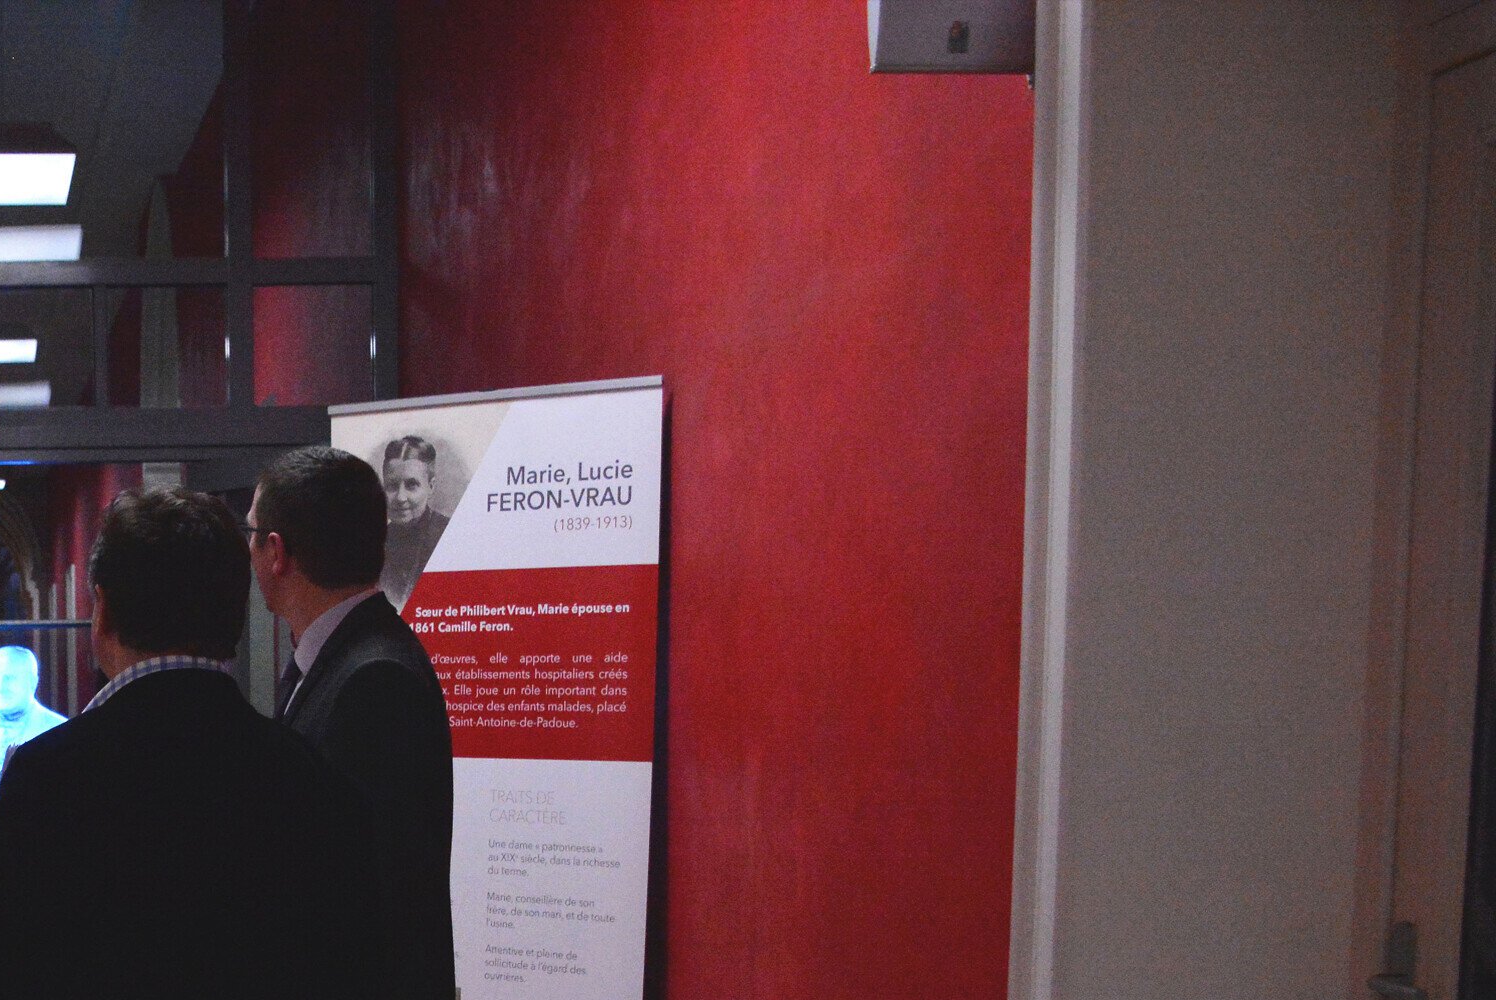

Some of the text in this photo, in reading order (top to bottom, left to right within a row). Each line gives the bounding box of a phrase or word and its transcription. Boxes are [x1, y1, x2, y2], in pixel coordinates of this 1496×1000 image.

[506, 459, 633, 486] Marie, Lucie
[487, 485, 633, 512] FERON-VRAU
[554, 515, 633, 533] (1839-1913)
[415, 603, 630, 618] Sœur de Philibert Vrau, Marie épouse en
[409, 622, 513, 633] 1861 Camille Feron.
[489, 653, 508, 664] elle
[519, 654, 560, 666] apporte
[572, 654, 592, 663] une
[604, 652, 628, 663] aide
[455, 667, 530, 680] établissements
[534, 667, 594, 682] hospitaliers
[598, 669, 627, 680] créés
[454, 685, 472, 695] Elle
[476, 685, 498, 697] joue
[503, 686, 516, 695] un
[521, 684, 540, 695] rôle
[545, 685, 596, 697] important
[601, 685, 627, 695] dans
[487, 701, 505, 712] des
[508, 701, 545, 712] enfants
[548, 701, 594, 713] malades,
[597, 702, 626, 714] placé
[536, 790, 555, 805] DE
[488, 840, 506, 849] Une
[508, 840, 533, 850] dame
[550, 855, 571, 865] dans
[565, 897, 576, 906] de
[579, 899, 595, 907] son
[511, 907, 522, 916] de
[524, 909, 539, 917] son
[577, 911, 589, 921] de
[566, 950, 578, 960] de
